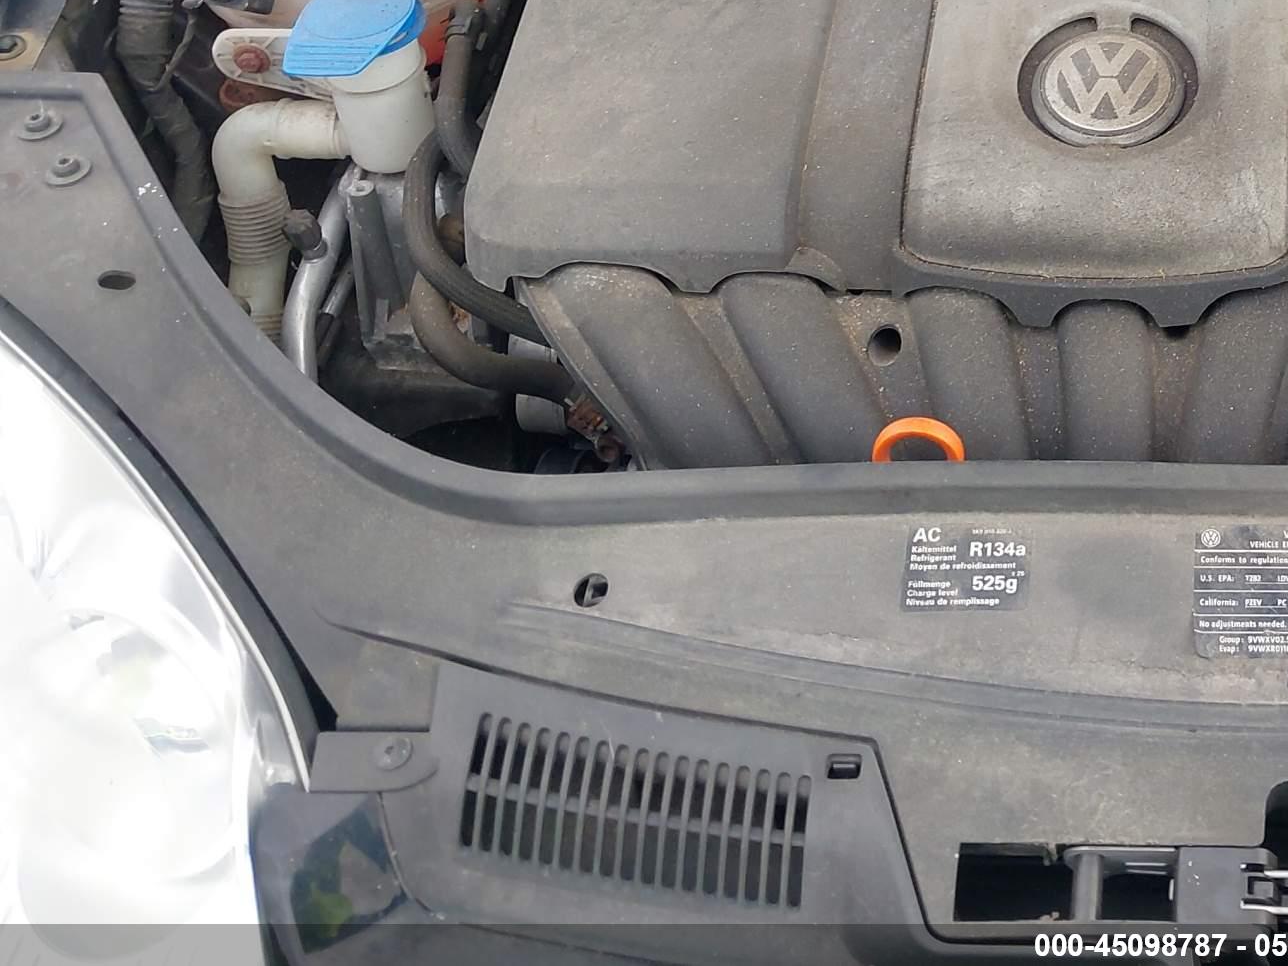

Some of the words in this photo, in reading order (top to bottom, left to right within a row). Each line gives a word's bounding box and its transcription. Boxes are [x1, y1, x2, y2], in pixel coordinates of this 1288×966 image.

[913, 527, 941, 543] AC
[911, 545, 957, 554] Kältemittel
[969, 541, 1026, 557] R134a
[1250, 541, 1279, 549] VEHICLE
[910, 554, 957, 563] Refrigerant
[1200, 555, 1235, 564] Conforms
[1239, 555, 1247, 563] to
[909, 563, 938, 572] Moyen
[952, 562, 1016, 570] refroidissement
[1218, 574, 1235, 582] EPA:
[972, 575, 1018, 594] 525g
[907, 589, 936, 599] Charge
[938, 589, 958, 597] level
[905, 598, 935, 606] Niveau
[937, 598, 948, 606] de
[949, 596, 1000, 607] remplissage
[1200, 596, 1239, 606] California:
[1199, 620, 1209, 628] No
[1211, 620, 1257, 630] adjustments
[1258, 620, 1287, 628] needed.
